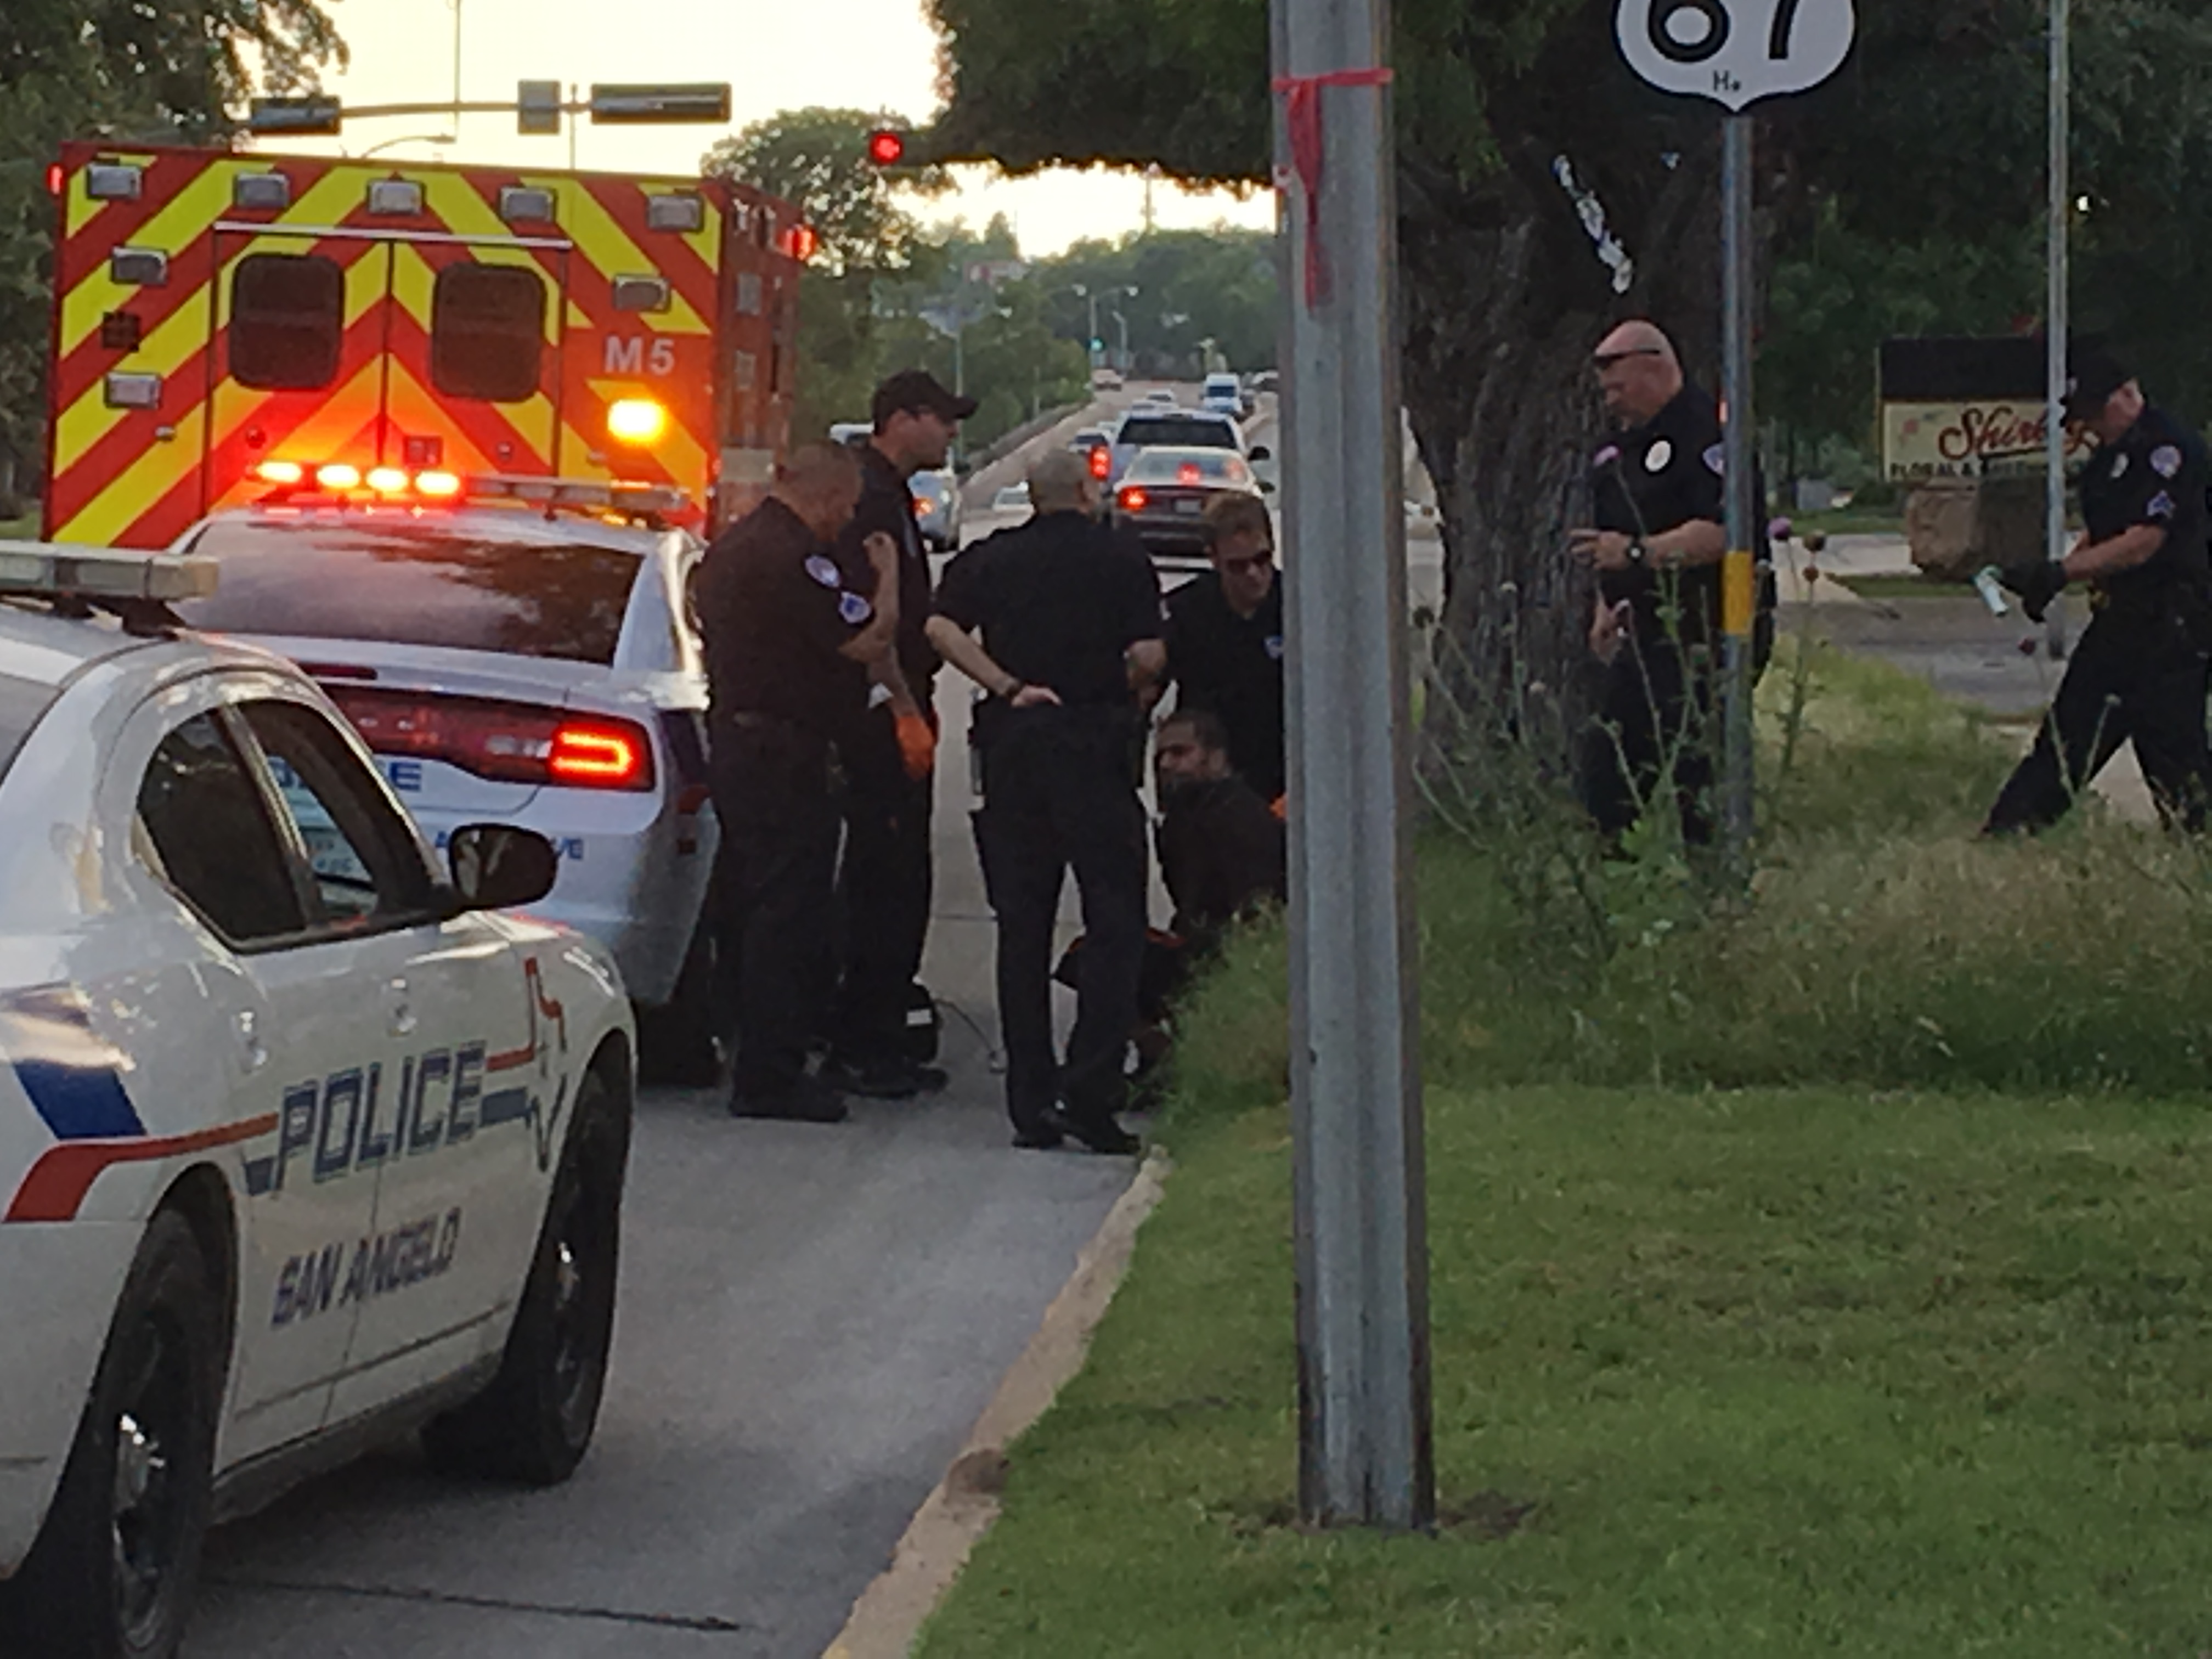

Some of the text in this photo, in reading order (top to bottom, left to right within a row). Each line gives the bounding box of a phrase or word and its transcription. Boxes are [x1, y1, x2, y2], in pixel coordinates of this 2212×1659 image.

[604, 335, 675, 376] M5
[272, 1040, 487, 1200] POLICE
[271, 1206, 461, 1329] SAN ANGELO
